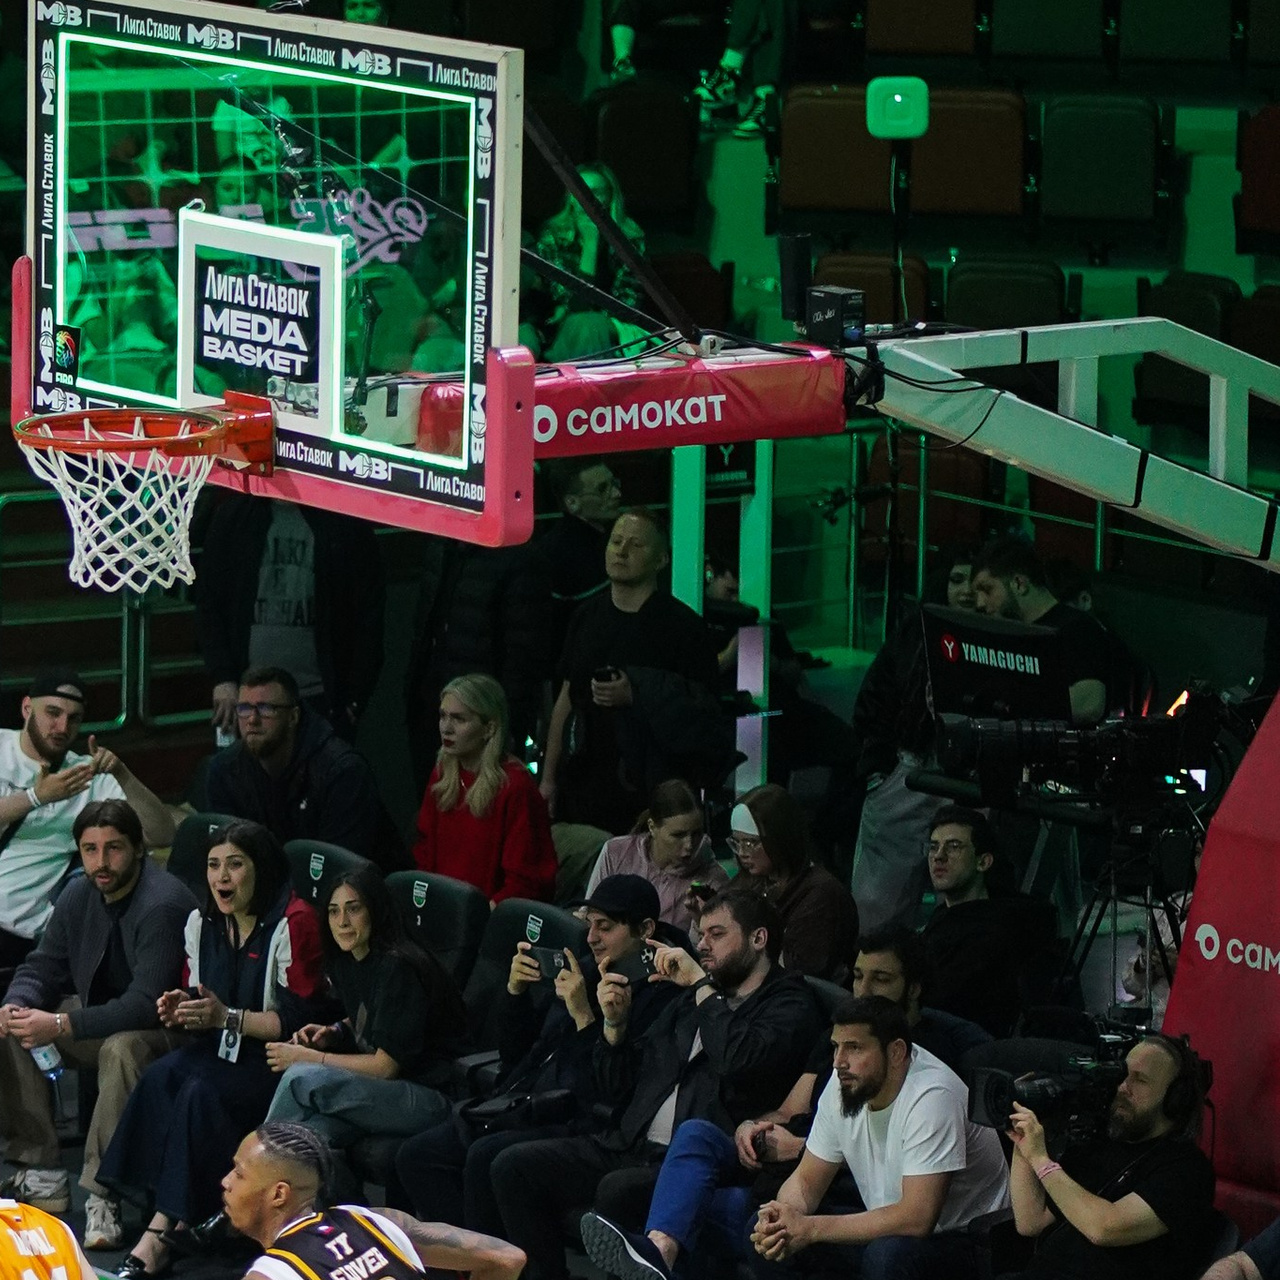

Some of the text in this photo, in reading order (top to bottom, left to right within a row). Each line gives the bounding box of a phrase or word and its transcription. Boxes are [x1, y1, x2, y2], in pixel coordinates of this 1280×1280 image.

[204, 304, 308, 351] MEDIA
[204, 335, 308, 376] BASKET
[962, 641, 1040, 676] YAMAGUCHI
[324, 1231, 354, 1260] TY
